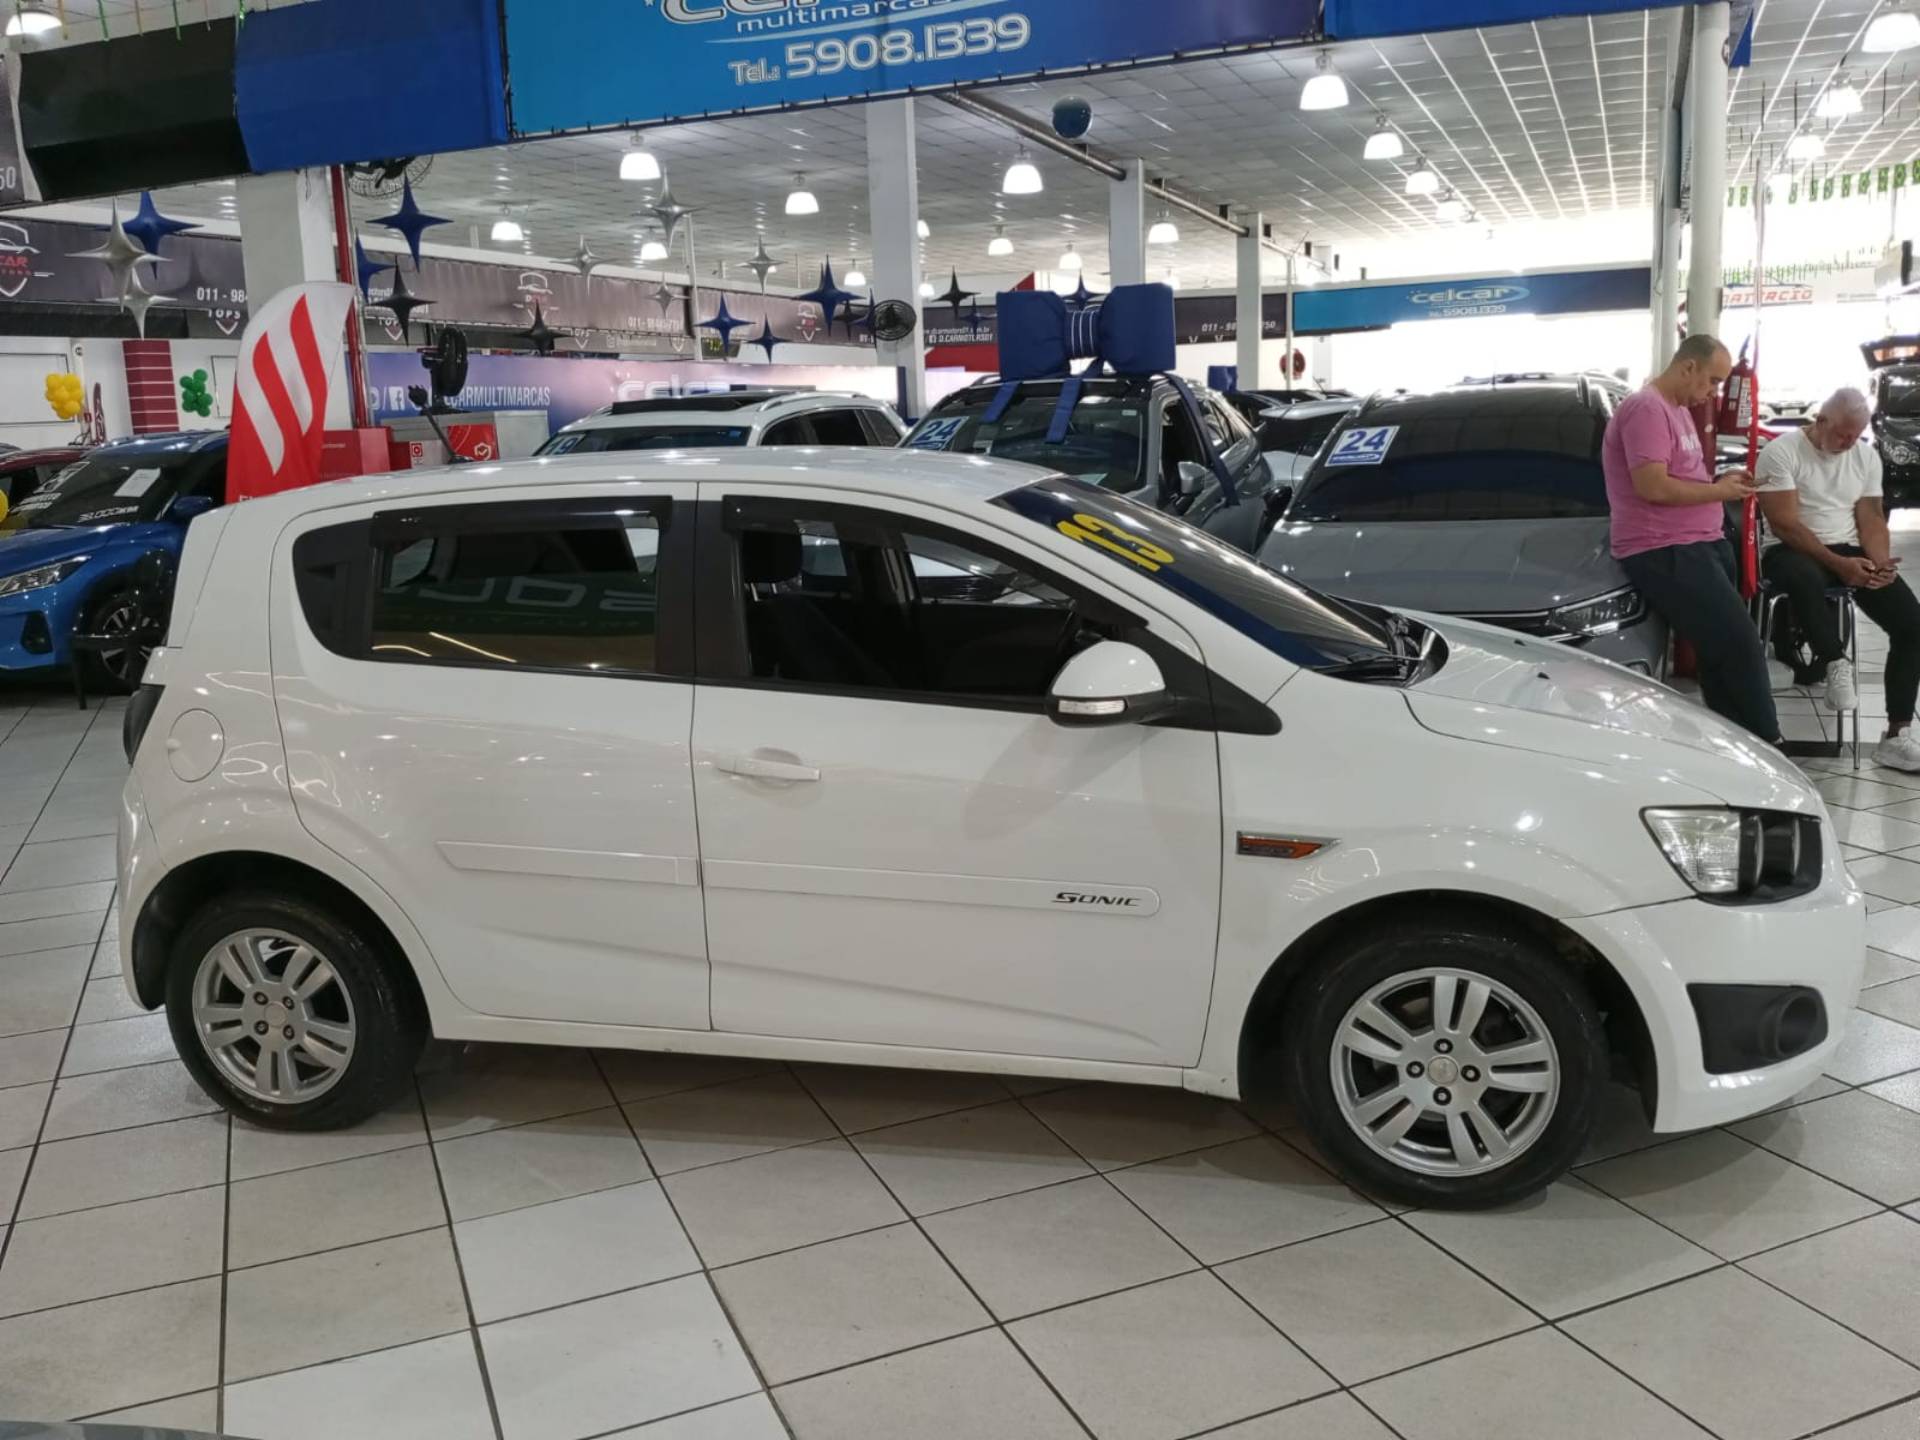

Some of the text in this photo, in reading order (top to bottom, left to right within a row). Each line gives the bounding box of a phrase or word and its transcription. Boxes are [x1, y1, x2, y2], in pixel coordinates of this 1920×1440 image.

[737, 0, 950, 33] multimarca
[785, 12, 1031, 79] 5908.1339
[196, 287, 218, 301] 011
[230, 288, 248, 303] 98
[1411, 287, 1510, 304] celcar
[914, 418, 962, 442] 24
[1339, 428, 1390, 453] 24
